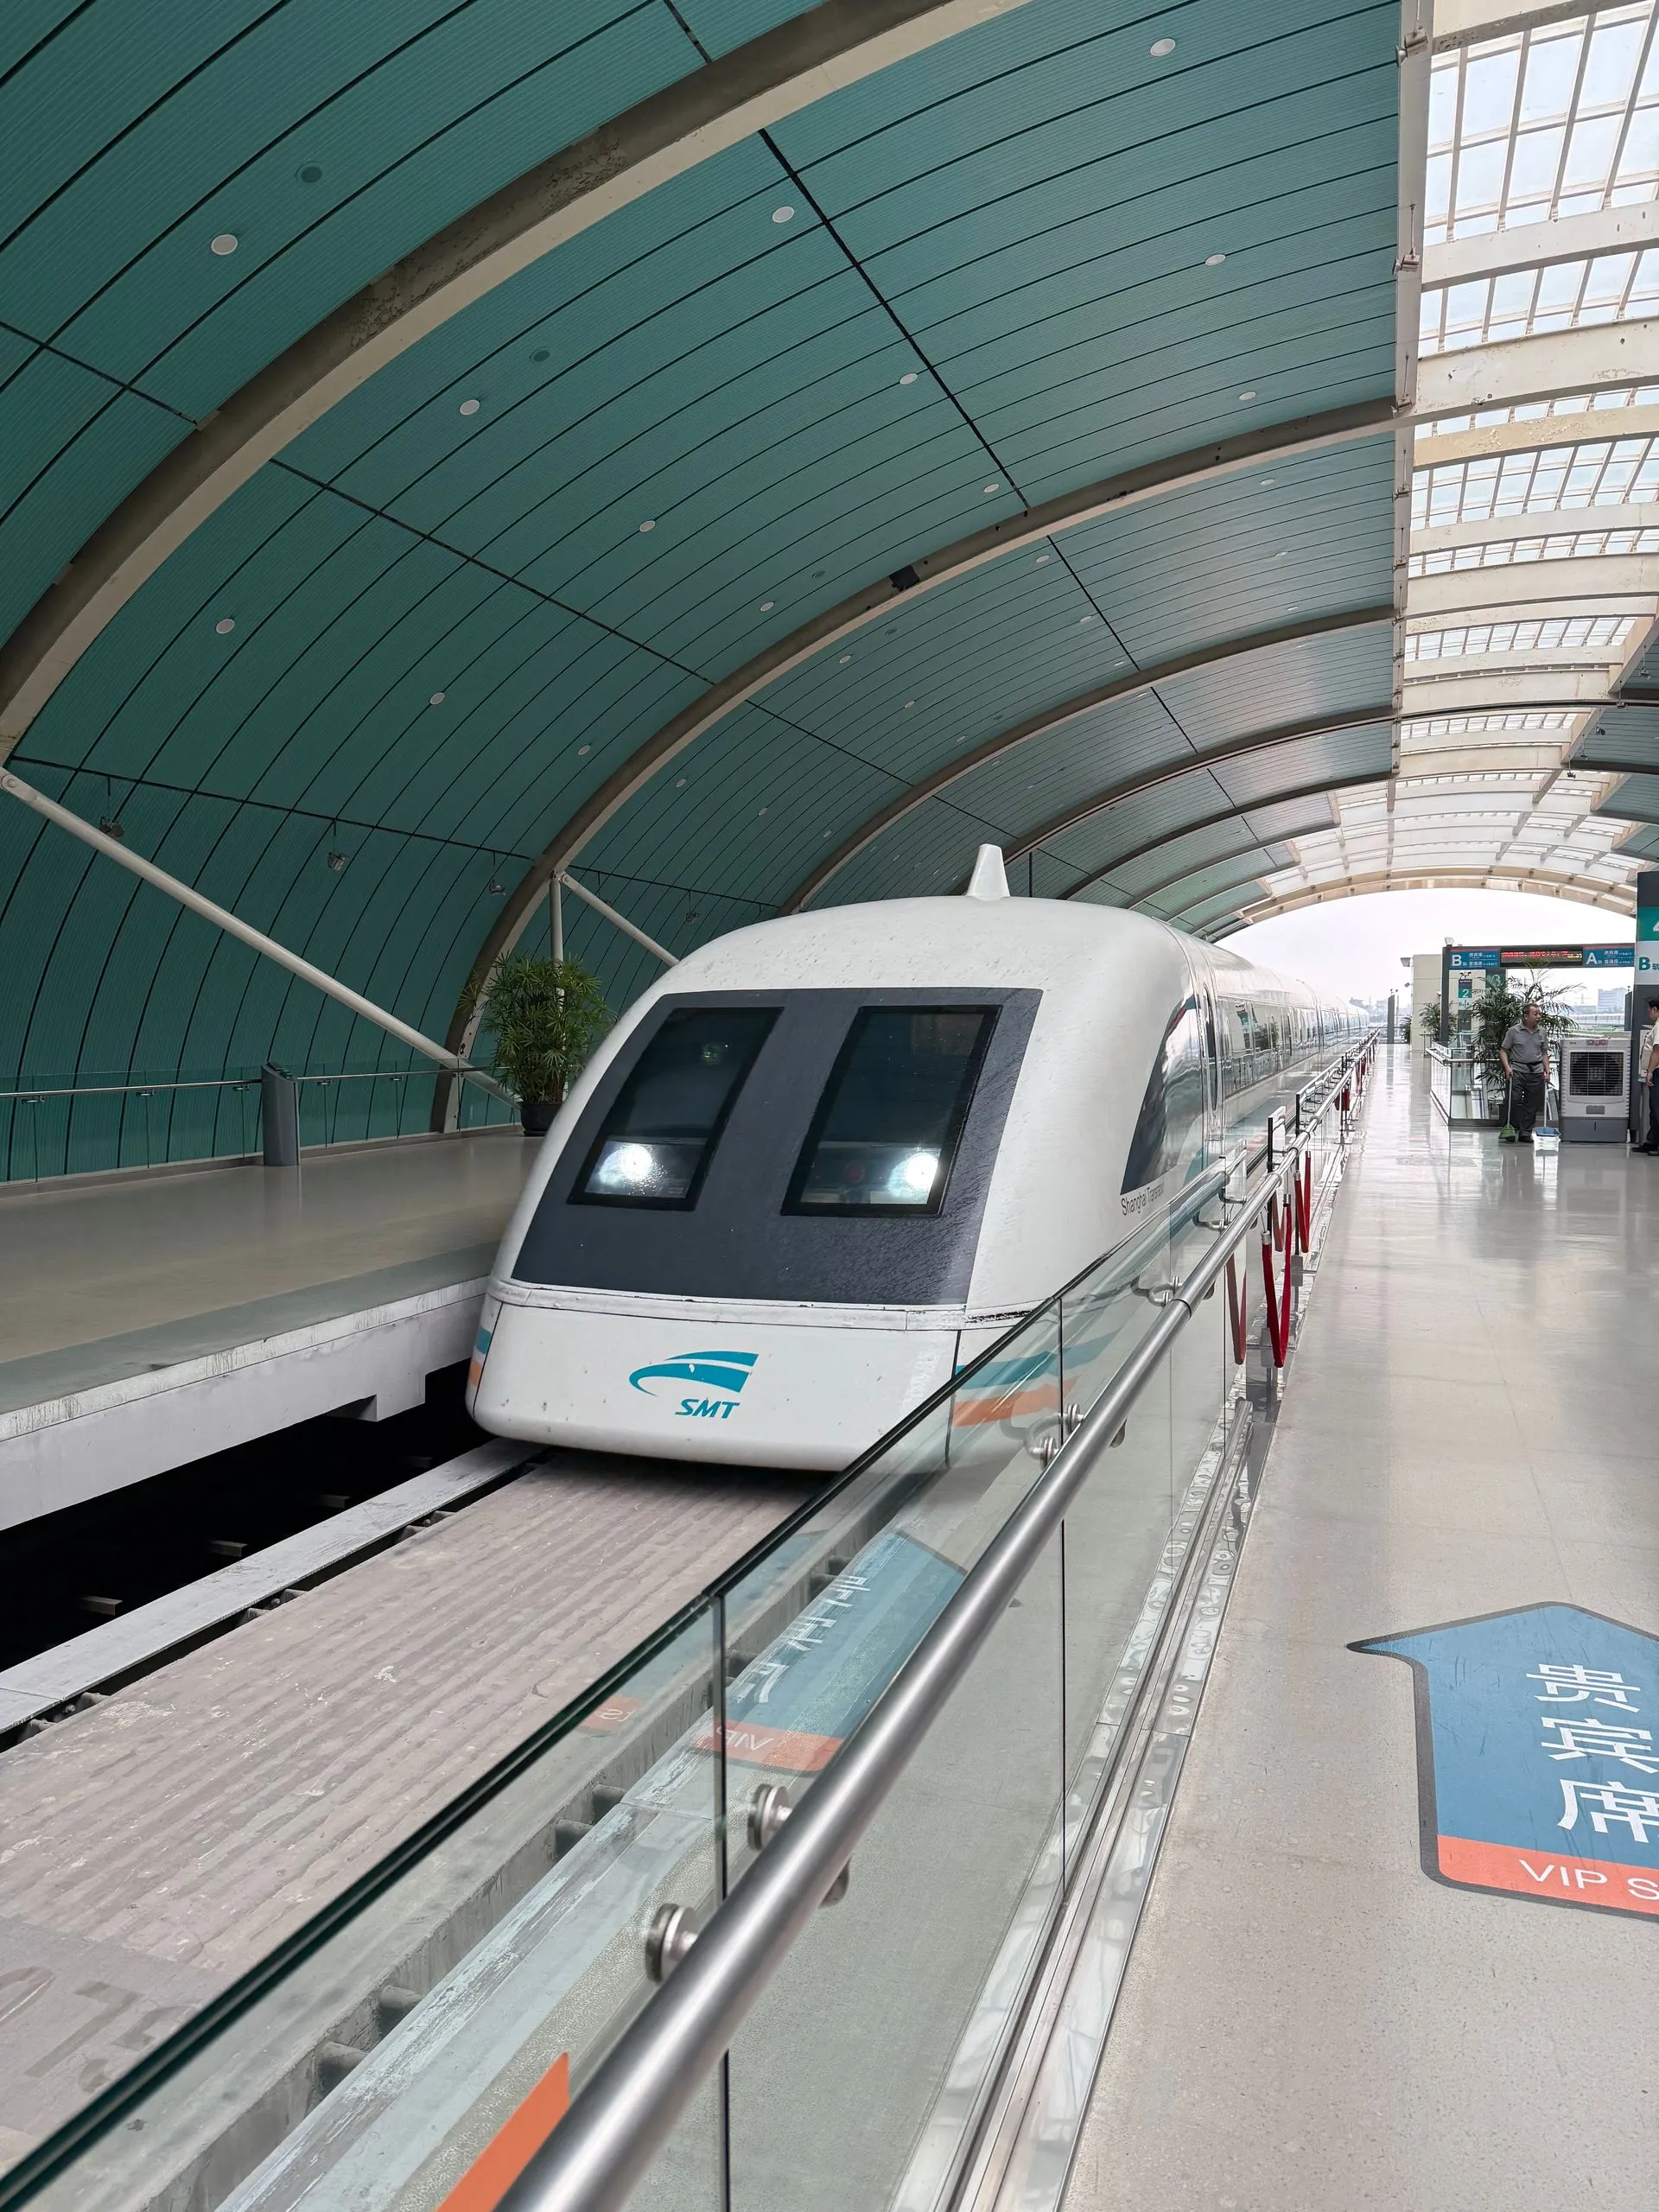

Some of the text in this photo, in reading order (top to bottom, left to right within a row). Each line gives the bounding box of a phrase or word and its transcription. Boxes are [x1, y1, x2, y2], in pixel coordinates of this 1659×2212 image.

[1452, 954, 1462, 967] B
[1586, 952, 1598, 965] A
[1638, 957, 1650, 971] B
[1462, 988, 1470, 998] 2
[1121, 1191, 1147, 1216] Shanghai
[675, 1398, 741, 1419] SMT
[1519, 1859, 1608, 1890] VIP
